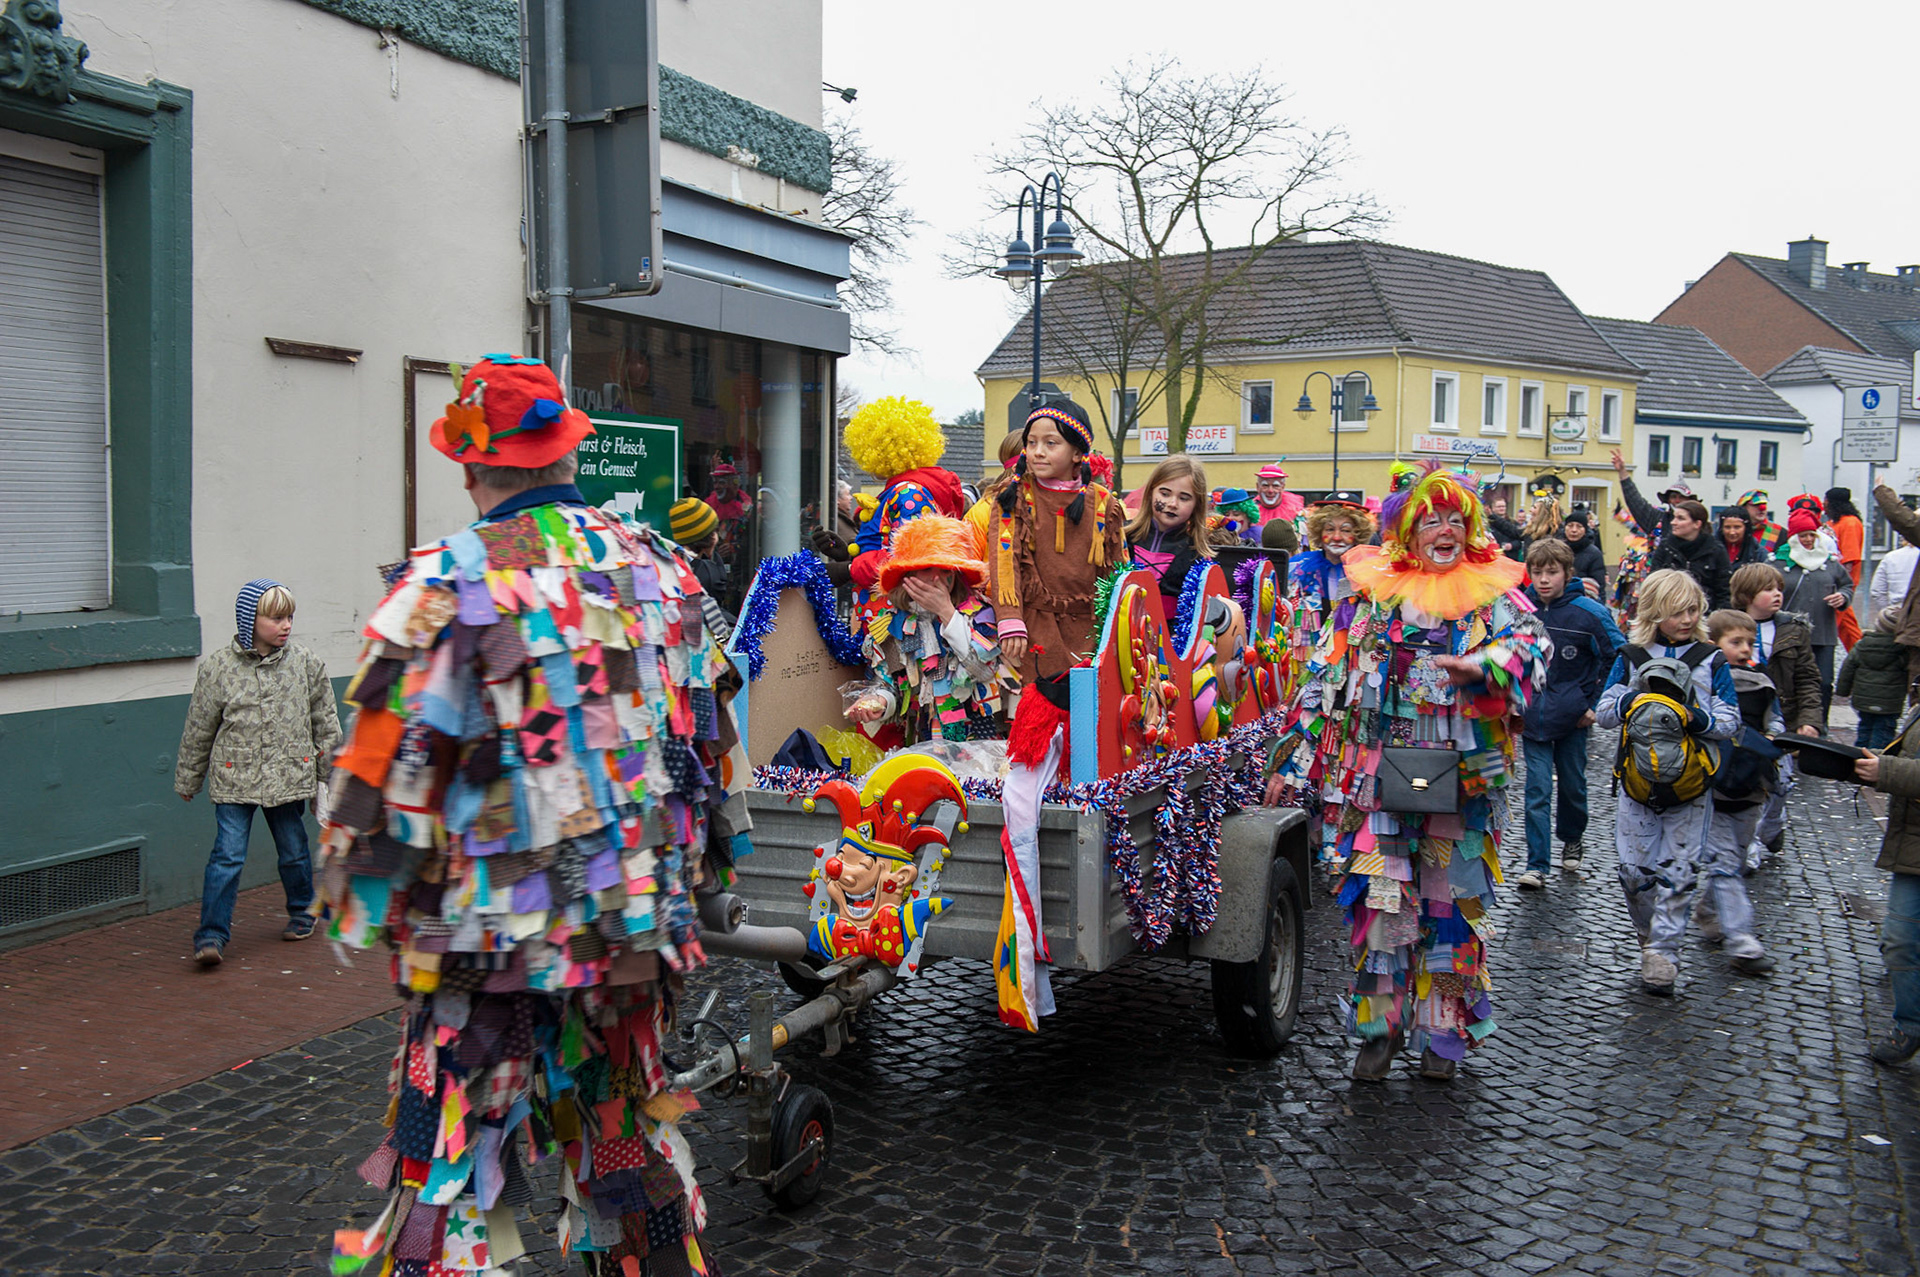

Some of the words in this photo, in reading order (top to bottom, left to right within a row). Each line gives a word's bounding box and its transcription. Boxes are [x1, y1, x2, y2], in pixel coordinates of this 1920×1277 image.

[576, 438, 599, 453] urst
[601, 435, 613, 454] &
[614, 436, 648, 458] Fleisch,
[580, 458, 597, 475] ein
[599, 458, 638, 477] Genuss!
